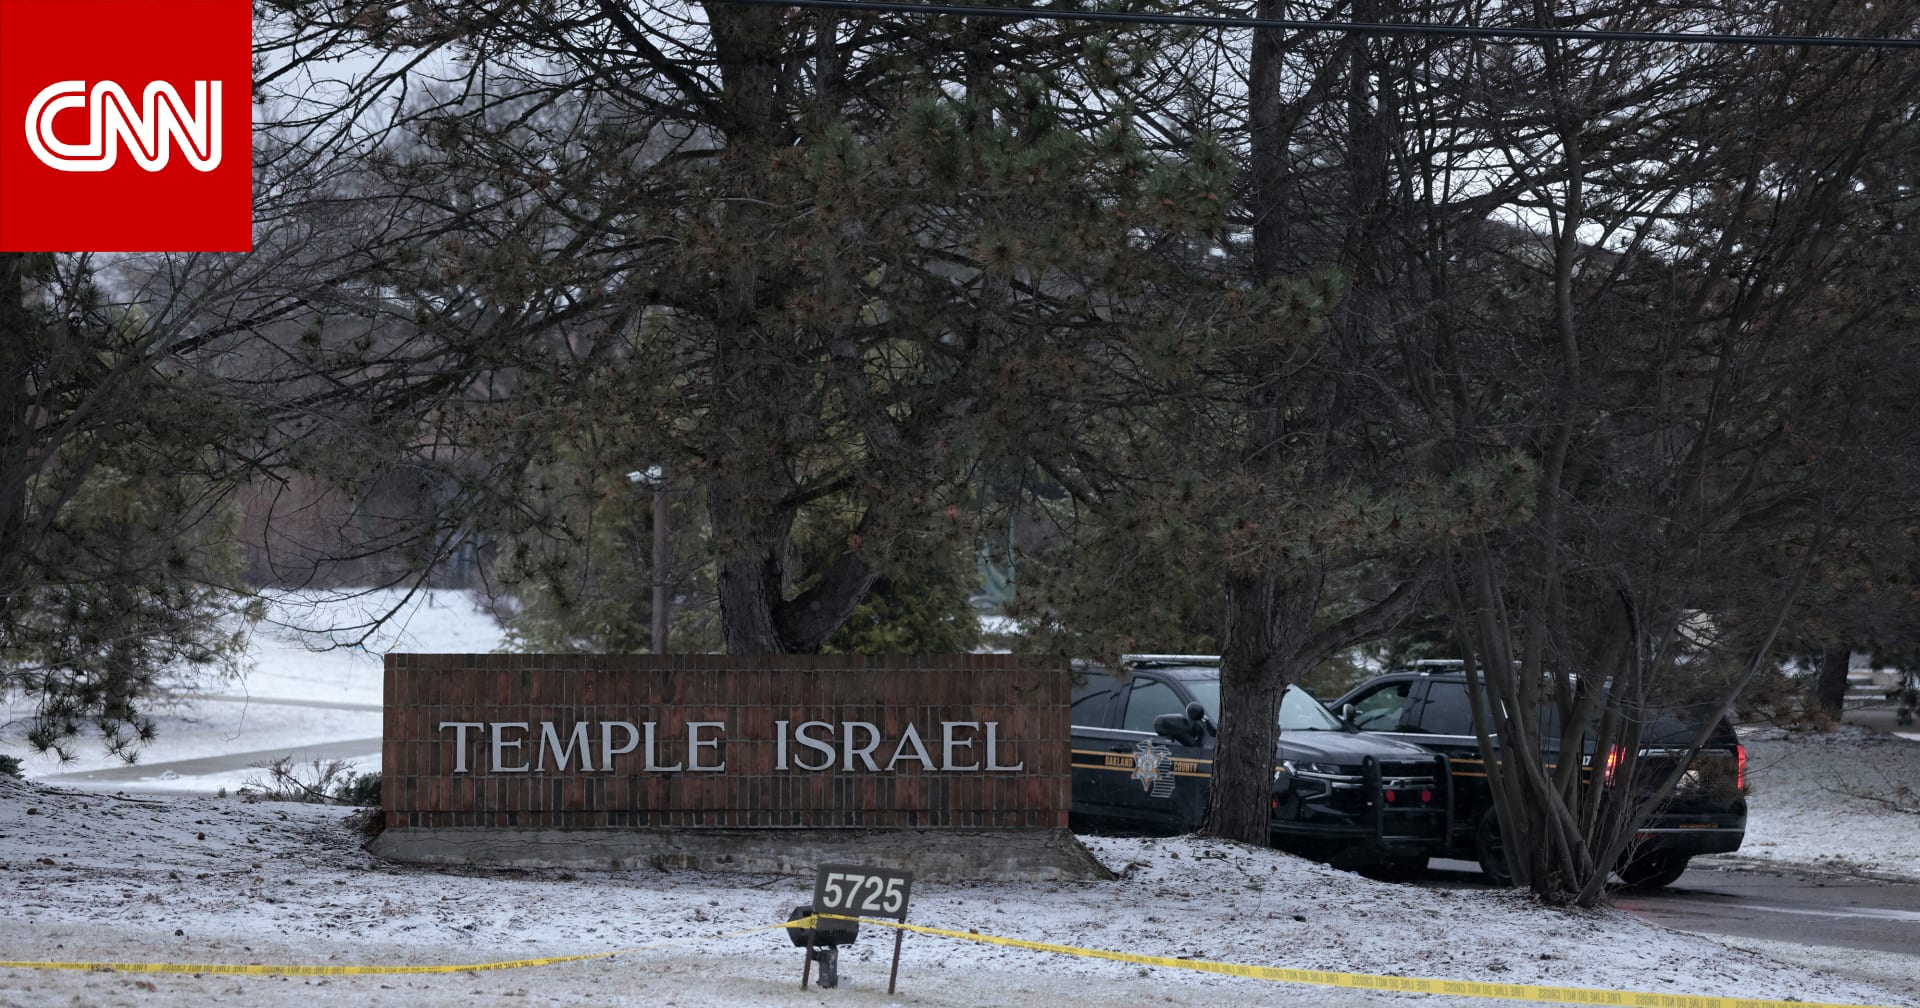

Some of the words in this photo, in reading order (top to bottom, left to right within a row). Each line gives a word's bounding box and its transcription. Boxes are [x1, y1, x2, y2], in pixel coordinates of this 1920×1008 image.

[438, 721, 726, 773] TEMPLE
[774, 720, 1024, 772] ISRAEL
[1105, 756, 1133, 768] OAKLAND
[1173, 762, 1198, 773] COUNTY
[822, 872, 904, 913] 5725
